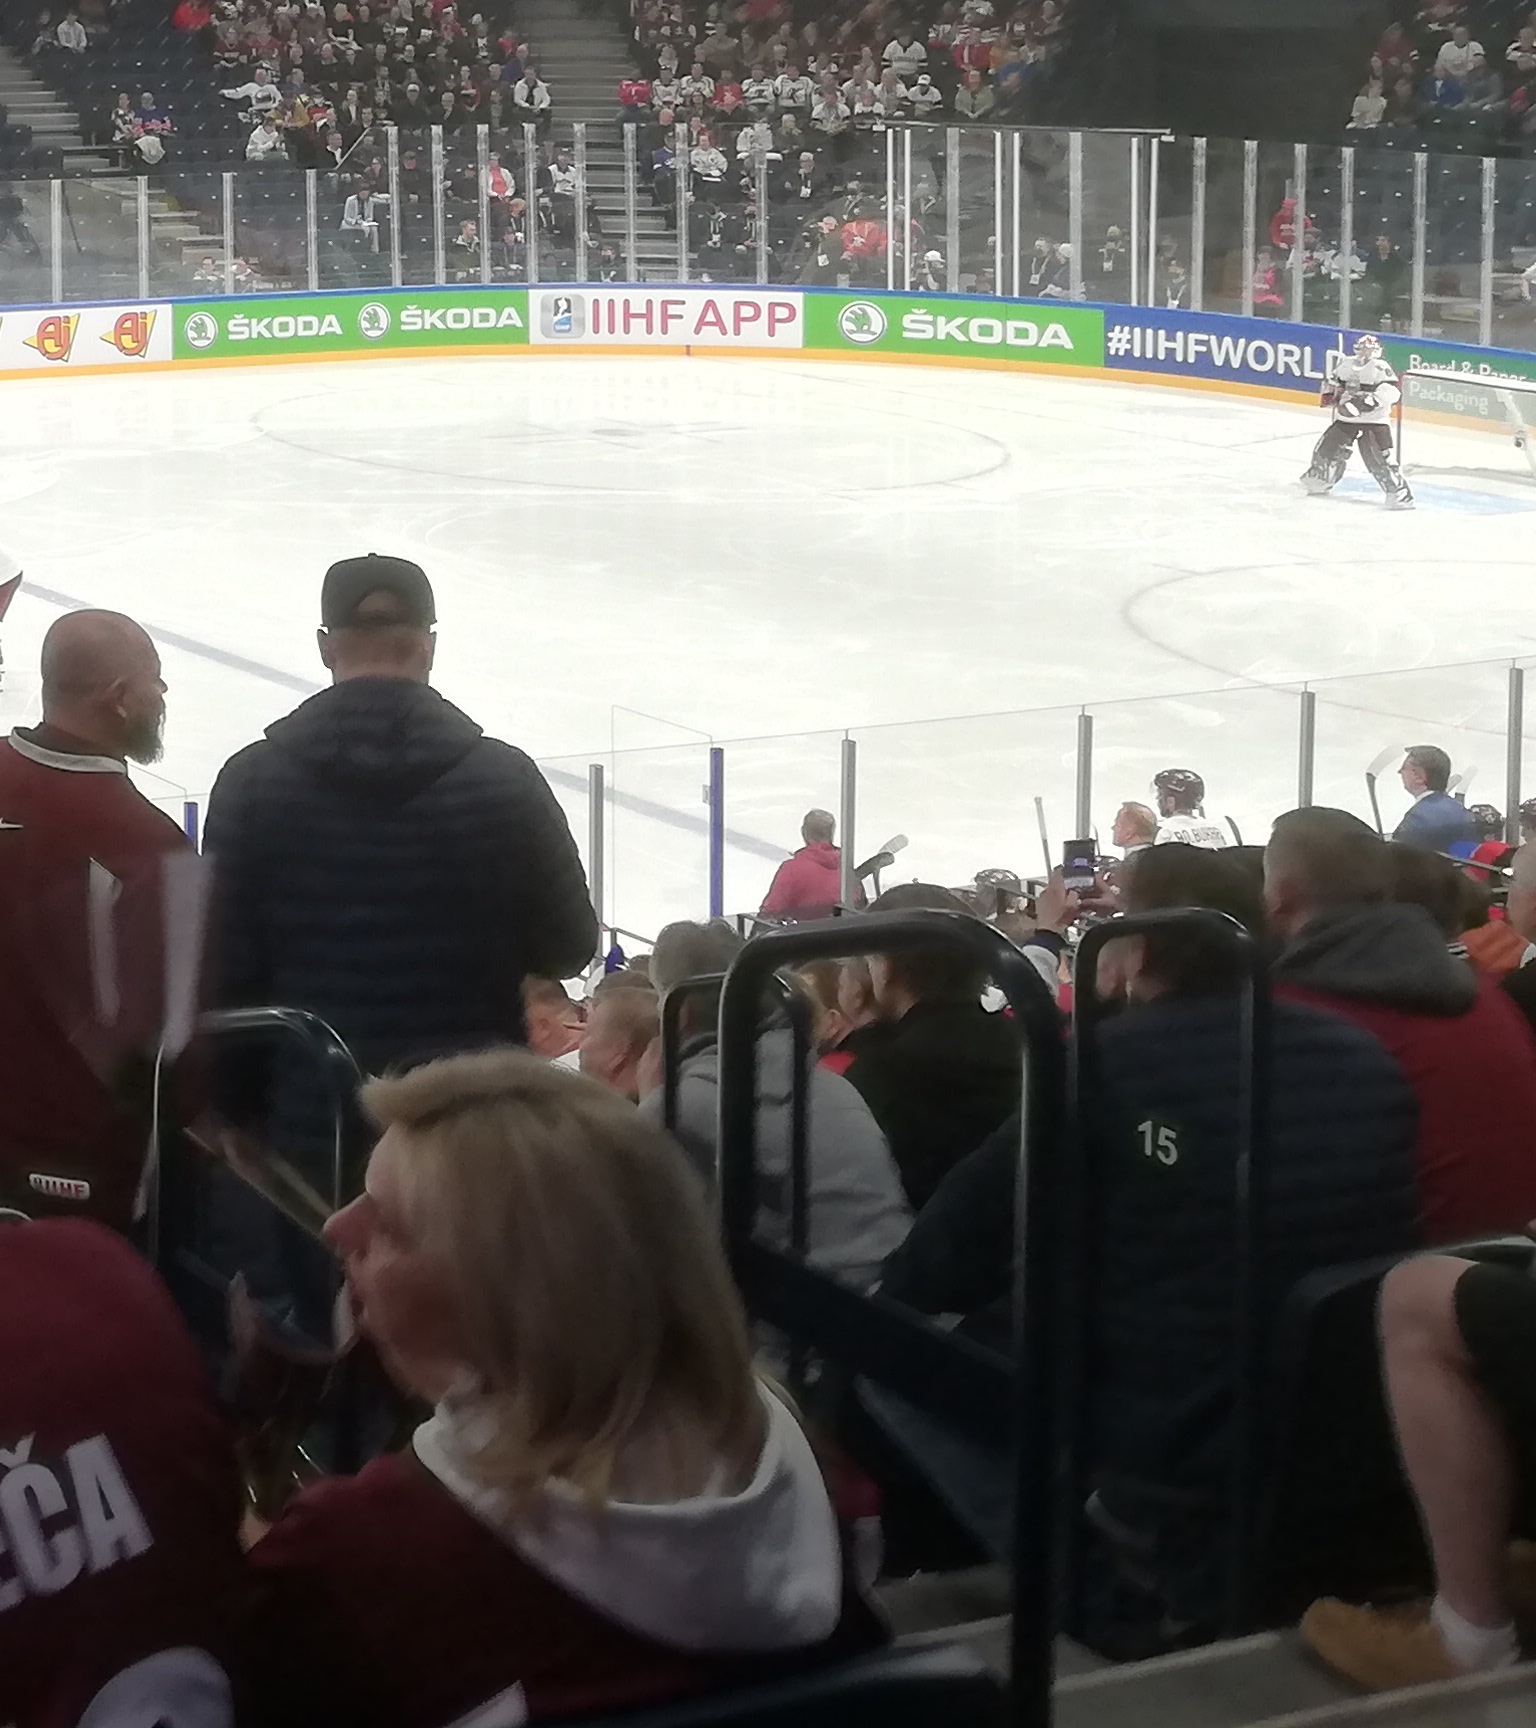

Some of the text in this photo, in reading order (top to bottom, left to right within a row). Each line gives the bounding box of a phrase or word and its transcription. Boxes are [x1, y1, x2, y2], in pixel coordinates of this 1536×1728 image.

[228, 311, 344, 340] ŠKODA
[400, 303, 524, 332] ŠKODA
[592, 298, 797, 337] IIHF APP
[901, 307, 1075, 350] ŠKODA
[1137, 1117, 1180, 1168] 15
